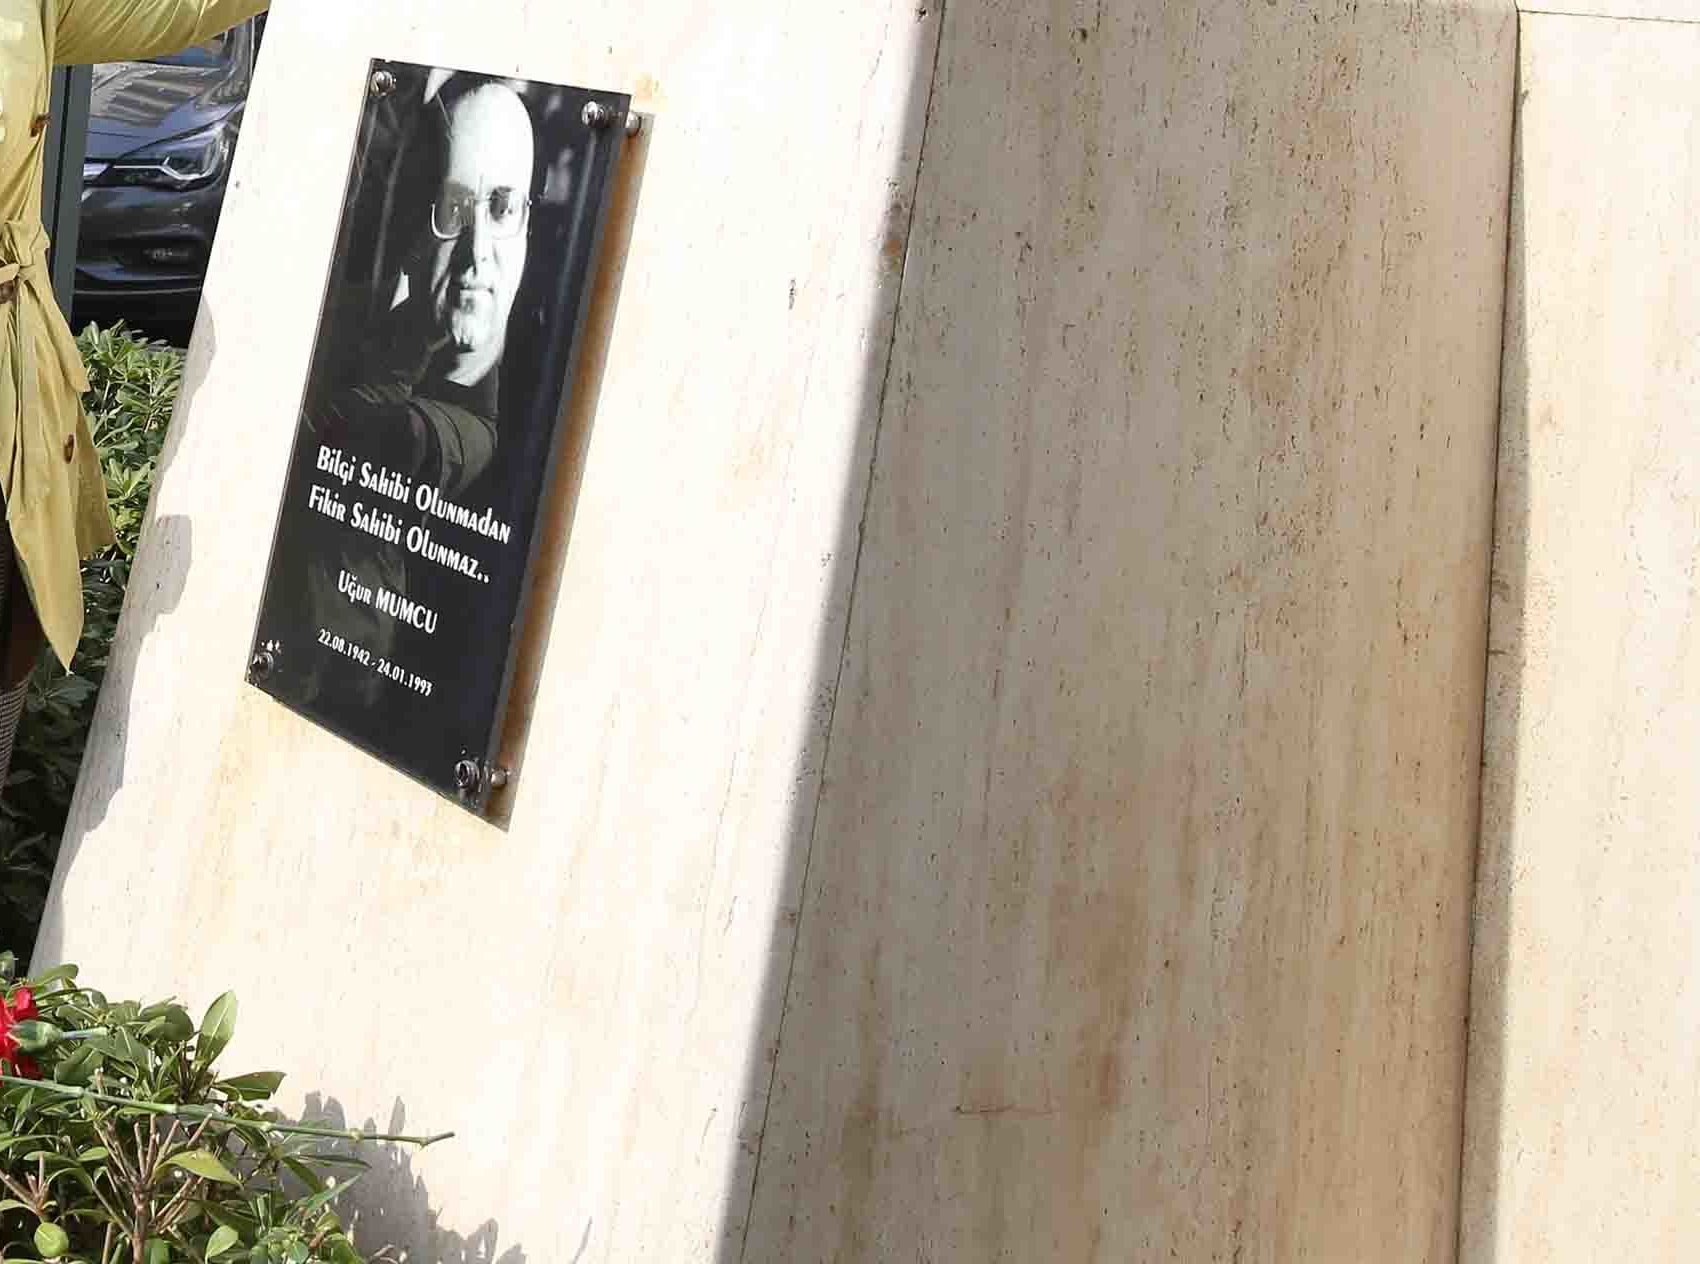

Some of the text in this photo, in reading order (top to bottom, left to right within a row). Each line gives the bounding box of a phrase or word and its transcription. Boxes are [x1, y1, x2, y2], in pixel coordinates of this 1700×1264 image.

[317, 445, 357, 486] Bilgi
[359, 462, 412, 504] Sahibi
[308, 485, 346, 522] Fikir
[351, 502, 403, 545] Sahibi
[338, 570, 438, 634] Uğur MUMCU
[317, 628, 371, 666] 22.08.1942
[377, 658, 433, 697] 24.01.1993
